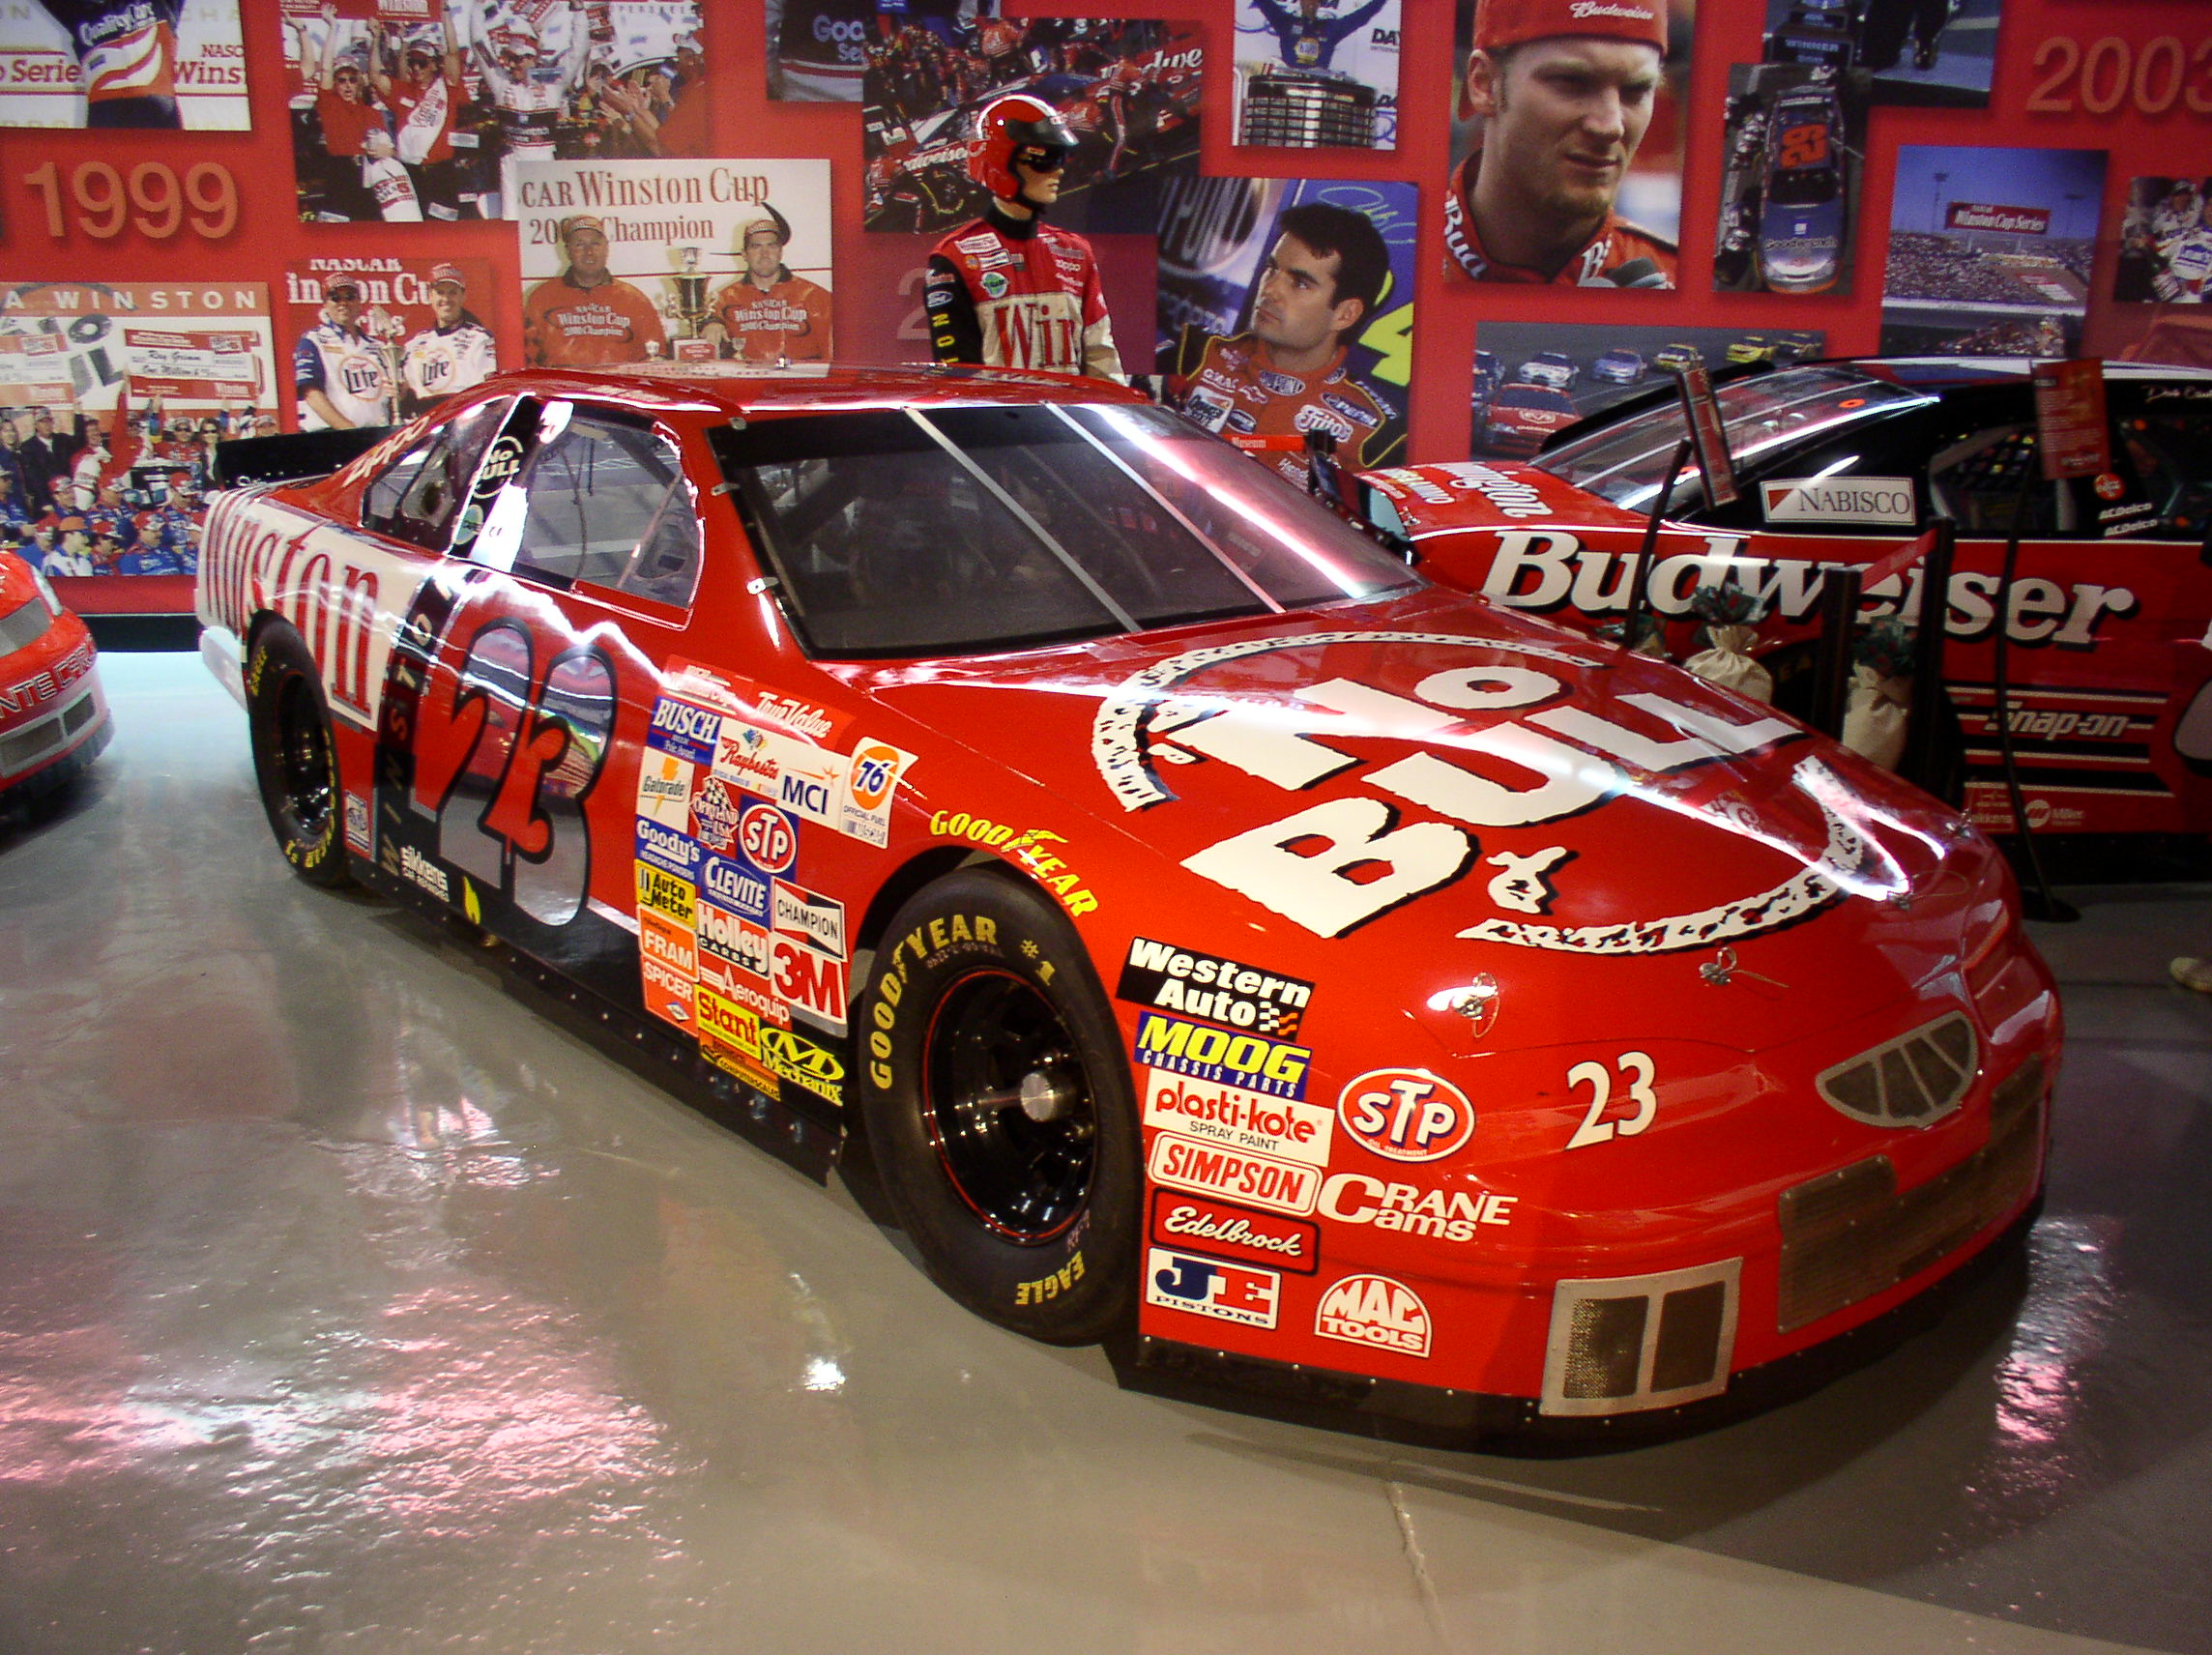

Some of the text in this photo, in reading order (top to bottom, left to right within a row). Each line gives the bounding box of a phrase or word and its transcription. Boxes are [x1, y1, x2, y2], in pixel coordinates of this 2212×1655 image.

[11, 58, 83, 83] Serie
[173, 60, 242, 84] Wins
[25, 161, 238, 239] 1999
[521, 166, 770, 208] CAR Winston Cup
[53, 290, 257, 309] WINSTON
[343, 369, 378, 394] Lite
[422, 361, 450, 387] Lite
[480, 460, 520, 479] ULL
[1798, 486, 1910, 515] NABISCO
[652, 699, 722, 743] BUSCH
[782, 699, 833, 740] Value
[642, 775, 685, 796] Gatorade
[782, 774, 830, 816] MCI
[854, 760, 893, 798] 76
[744, 812, 789, 861] STP
[1179, 691, 1802, 939] BULL
[635, 819, 701, 862] Goody's
[930, 809, 1098, 917] GOODYEAR
[652, 888, 694, 919] Meter
[654, 874, 686, 901] Auto
[705, 857, 767, 910] CLEVITE
[697, 903, 769, 973] Holley
[777, 898, 838, 941] CHAMPION
[644, 929, 694, 971] FRAM
[1129, 938, 1312, 1008] Western
[644, 961, 693, 1002] SPICER
[722, 965, 791, 1025] Aeroquip
[773, 942, 841, 1018] 3M
[870, 915, 998, 1089] GOODYEAR
[1154, 978, 1257, 1027] Auto
[698, 992, 759, 1047] Stant
[1137, 1016, 1313, 1085] MOOG
[1142, 1049, 1297, 1099] CHASSIS PARTS
[1155, 1082, 1317, 1145] plasti-kote
[1352, 1079, 1456, 1148] STP
[1565, 1050, 1658, 1150] 23
[1189, 1121, 1280, 1152] SPRAY PAINT
[1163, 1143, 1306, 1204] SIMPSON
[1317, 1173, 1519, 1226] CRANE
[1164, 1206, 1303, 1256] Edelbrock
[1015, 1251, 1085, 1305] EAGLE
[1155, 1256, 1276, 1316] JE
[1155, 1294, 1269, 1325] PISTONS
[1322, 1278, 1426, 1335] MAC
[1321, 1317, 1425, 1351] TOOLS
